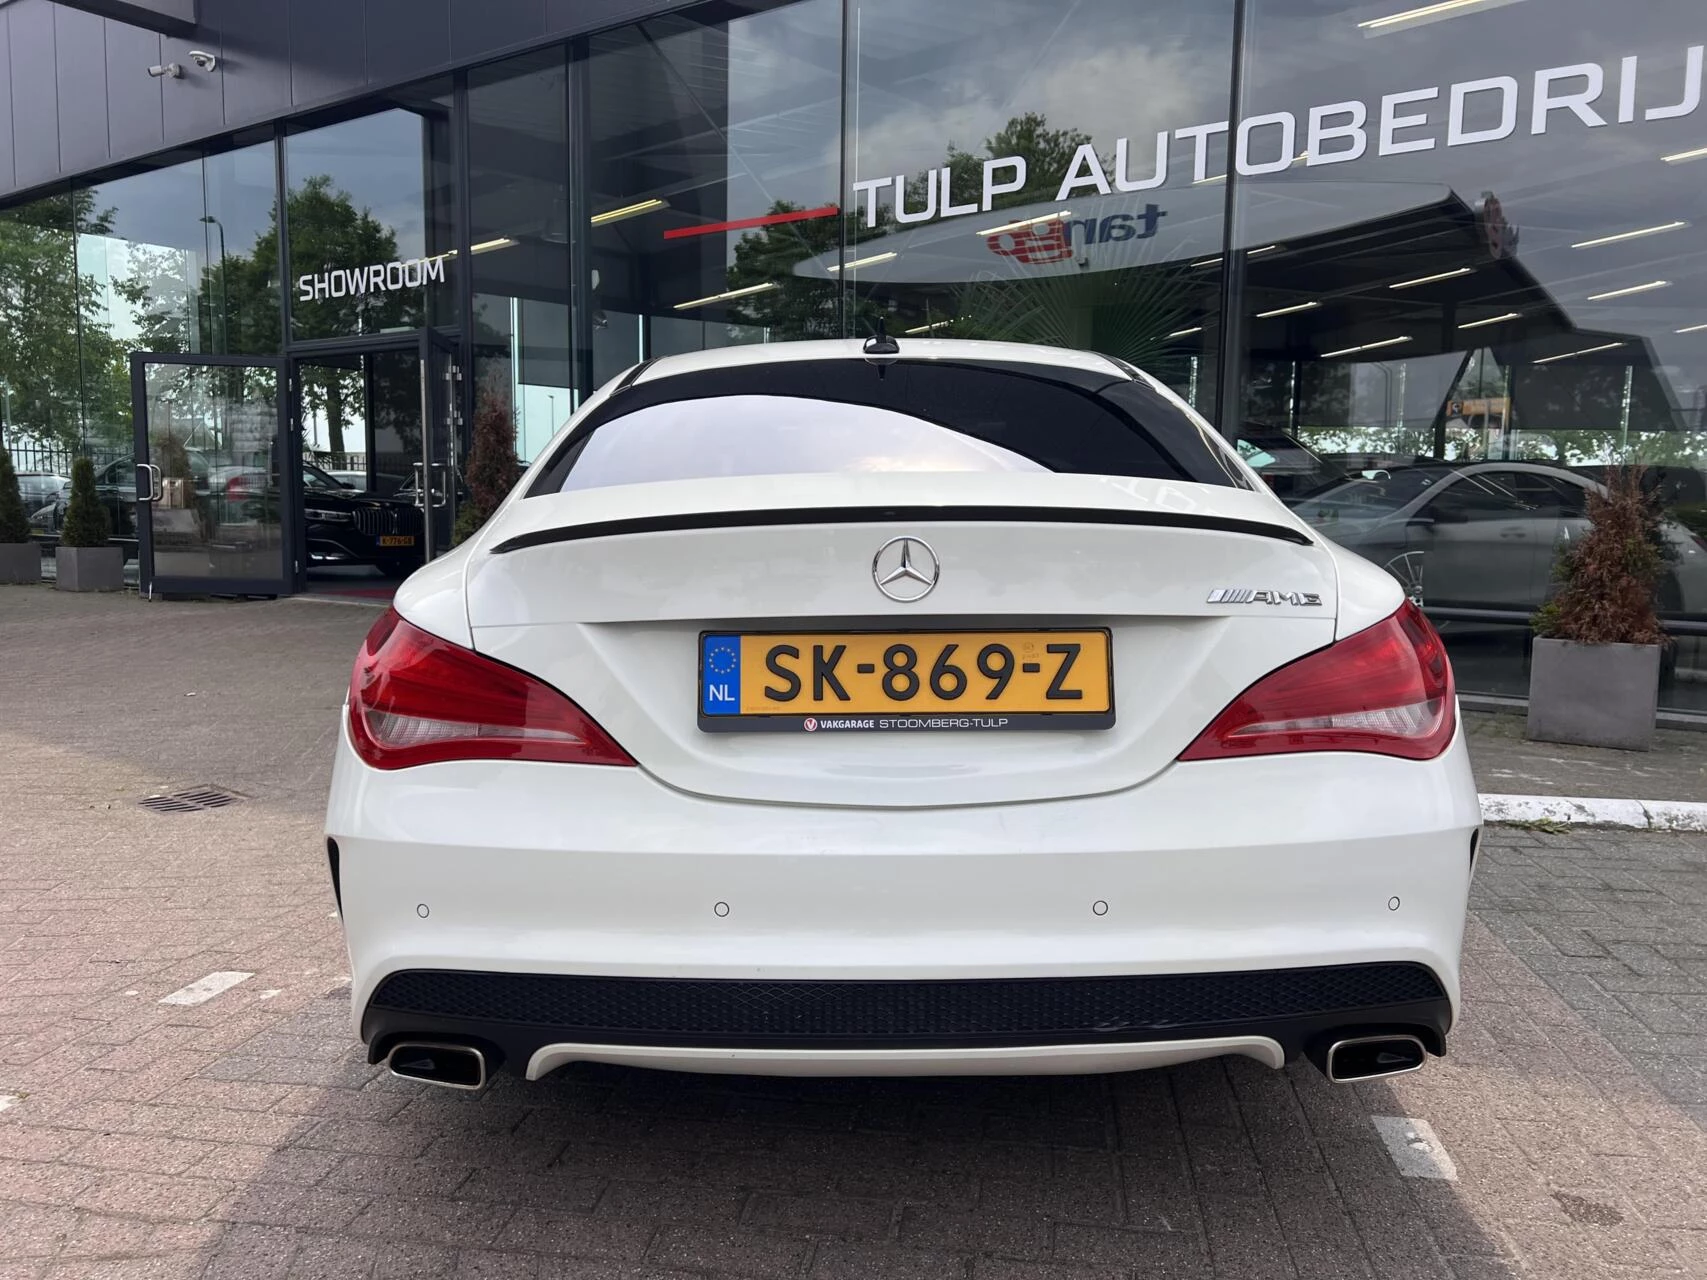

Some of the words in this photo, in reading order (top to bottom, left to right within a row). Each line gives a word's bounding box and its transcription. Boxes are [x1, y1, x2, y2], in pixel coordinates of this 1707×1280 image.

[853, 156, 1028, 228] TULP
[1056, 45, 1704, 201] AUTOBEDRIJ
[299, 258, 445, 301] SHOWROOM
[1246, 589, 1322, 606] AMG
[764, 643, 1083, 701] SK-869-Z
[709, 684, 735, 702] NL
[820, 719, 875, 730] VAKGARAGE
[879, 718, 1008, 729] STOOMBERG-TULP
